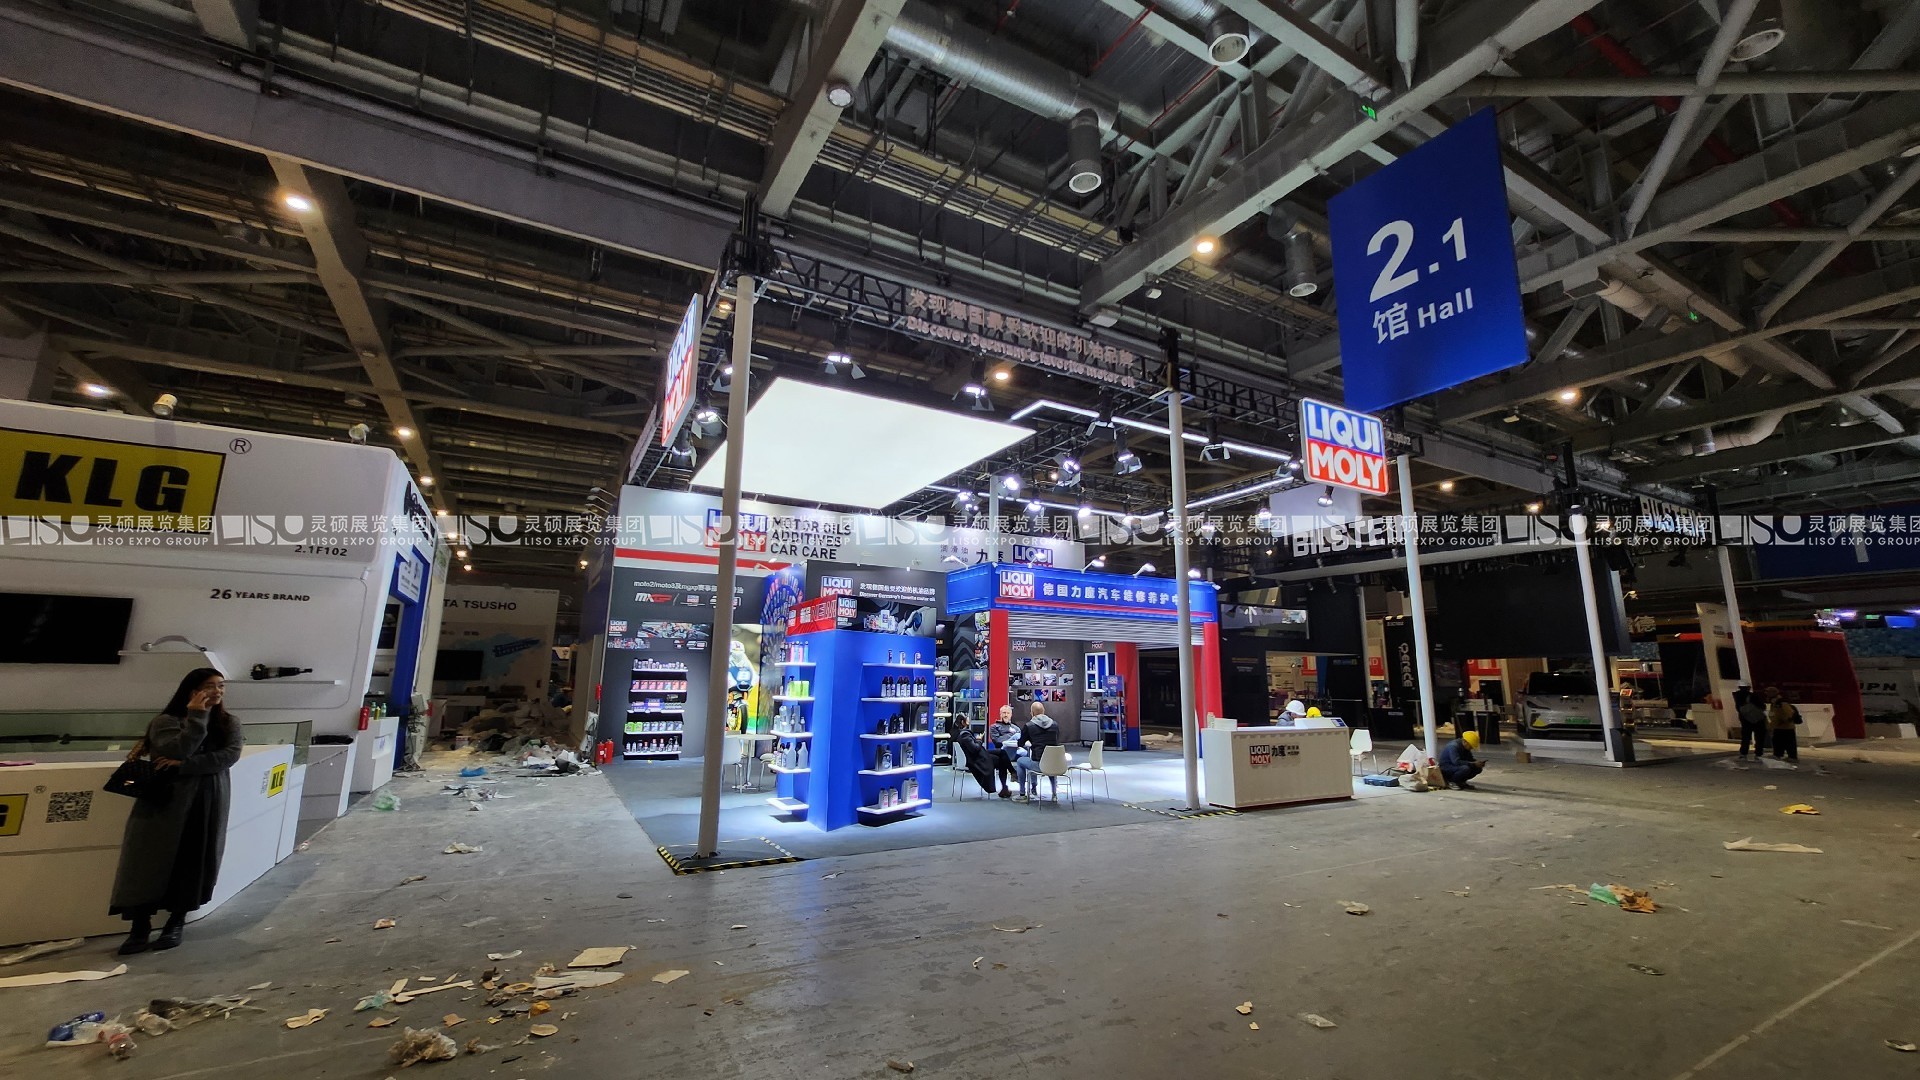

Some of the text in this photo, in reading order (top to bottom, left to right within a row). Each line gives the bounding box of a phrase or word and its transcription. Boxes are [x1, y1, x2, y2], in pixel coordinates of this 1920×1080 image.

[1367, 217, 1467, 303] 2.1
[1373, 288, 1473, 344] 馆 Hall
[909, 288, 1135, 368] 发现德国最受欢迎的机油品牌
[907, 315, 1135, 388] Discover Germany's favorite motor oil
[1307, 404, 1381, 454] LIQUI
[1310, 442, 1383, 489] MOLY
[15, 450, 190, 513] KLG
[709, 510, 766, 532] LUI
[772, 516, 852, 536] MOTOR OILS
[771, 530, 842, 548] ADDITIVES
[294, 544, 348, 557] 2.1F102
[770, 543, 837, 560] CAR CARE
[823, 577, 852, 588] LIQUI
[1002, 571, 1032, 585] LIQUI
[210, 588, 310, 602] 26 YEARS BRAND
[1002, 585, 1033, 597] MOLY
[1042, 581, 1190, 605] 德国力魔汽车维修养护中
[463, 600, 517, 611] TSUSHO
[839, 598, 857, 609] LIQUI
[839, 608, 857, 618] MOLY
[1250, 745, 1270, 754] LIQUI
[1251, 755, 1270, 764] MOLY
[271, 770, 285, 790] KLG
